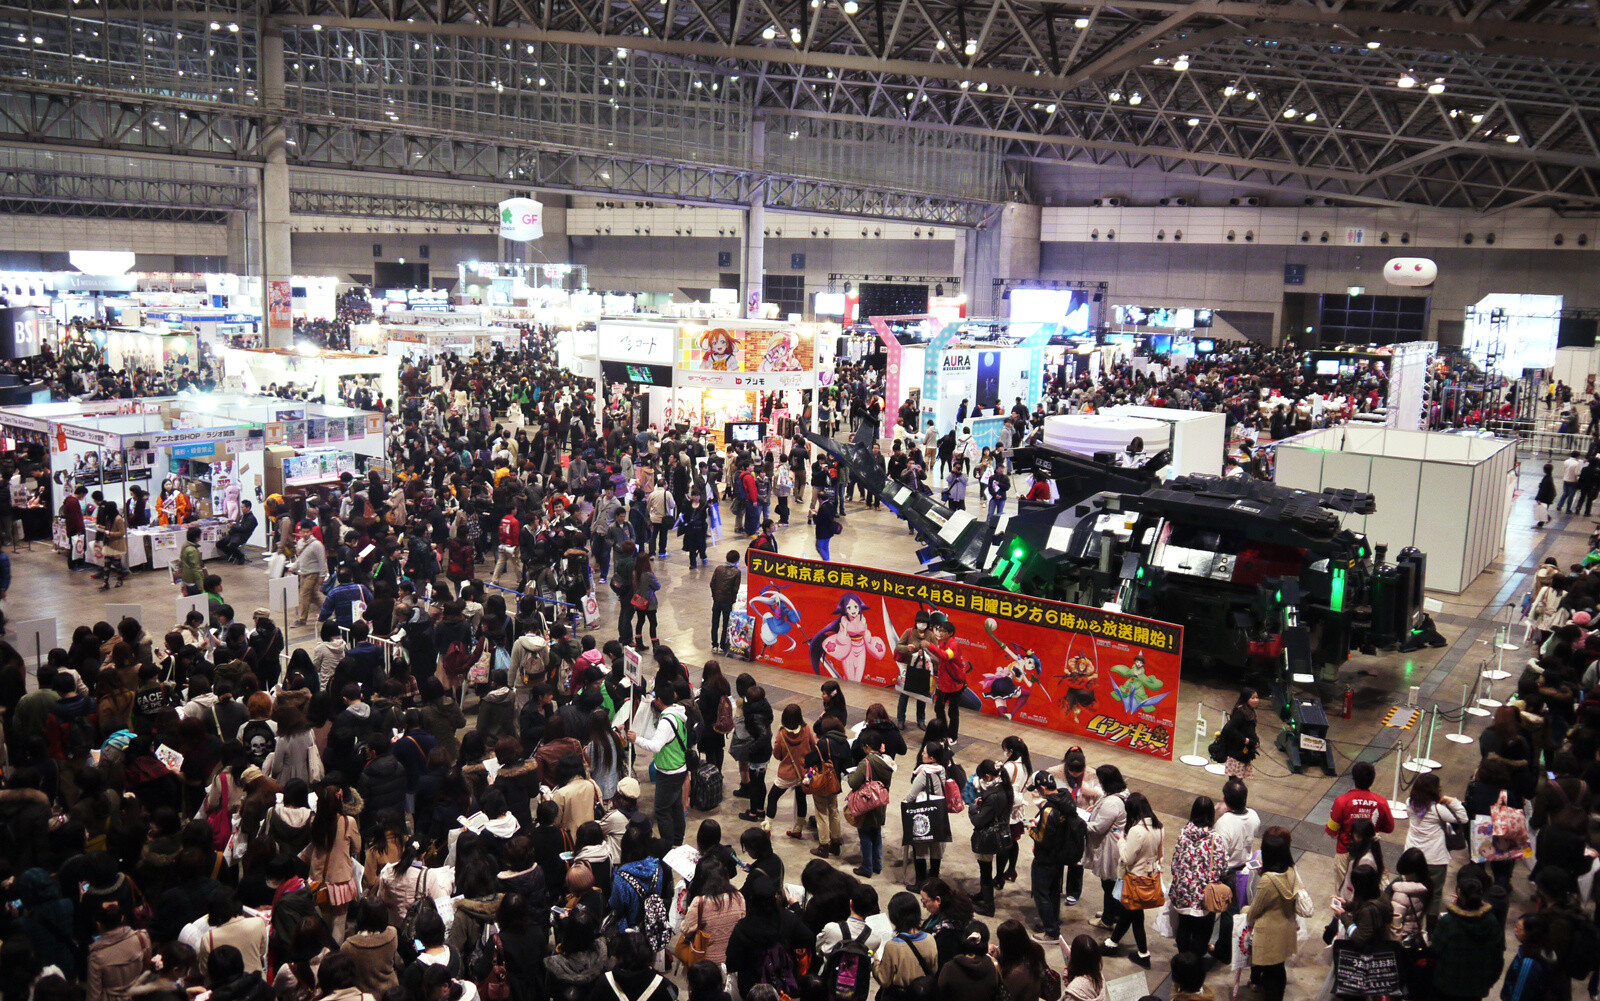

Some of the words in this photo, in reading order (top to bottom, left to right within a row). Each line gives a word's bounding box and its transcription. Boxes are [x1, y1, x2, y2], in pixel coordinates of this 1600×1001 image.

[522, 214, 538, 225] GF
[943, 355, 971, 366] AURA
[155, 433, 201, 442] アニたまSHOP
[205, 430, 235, 438] ラジオ関西
[138, 691, 163, 705] FACE
[1352, 799, 1378, 807] STAFF
